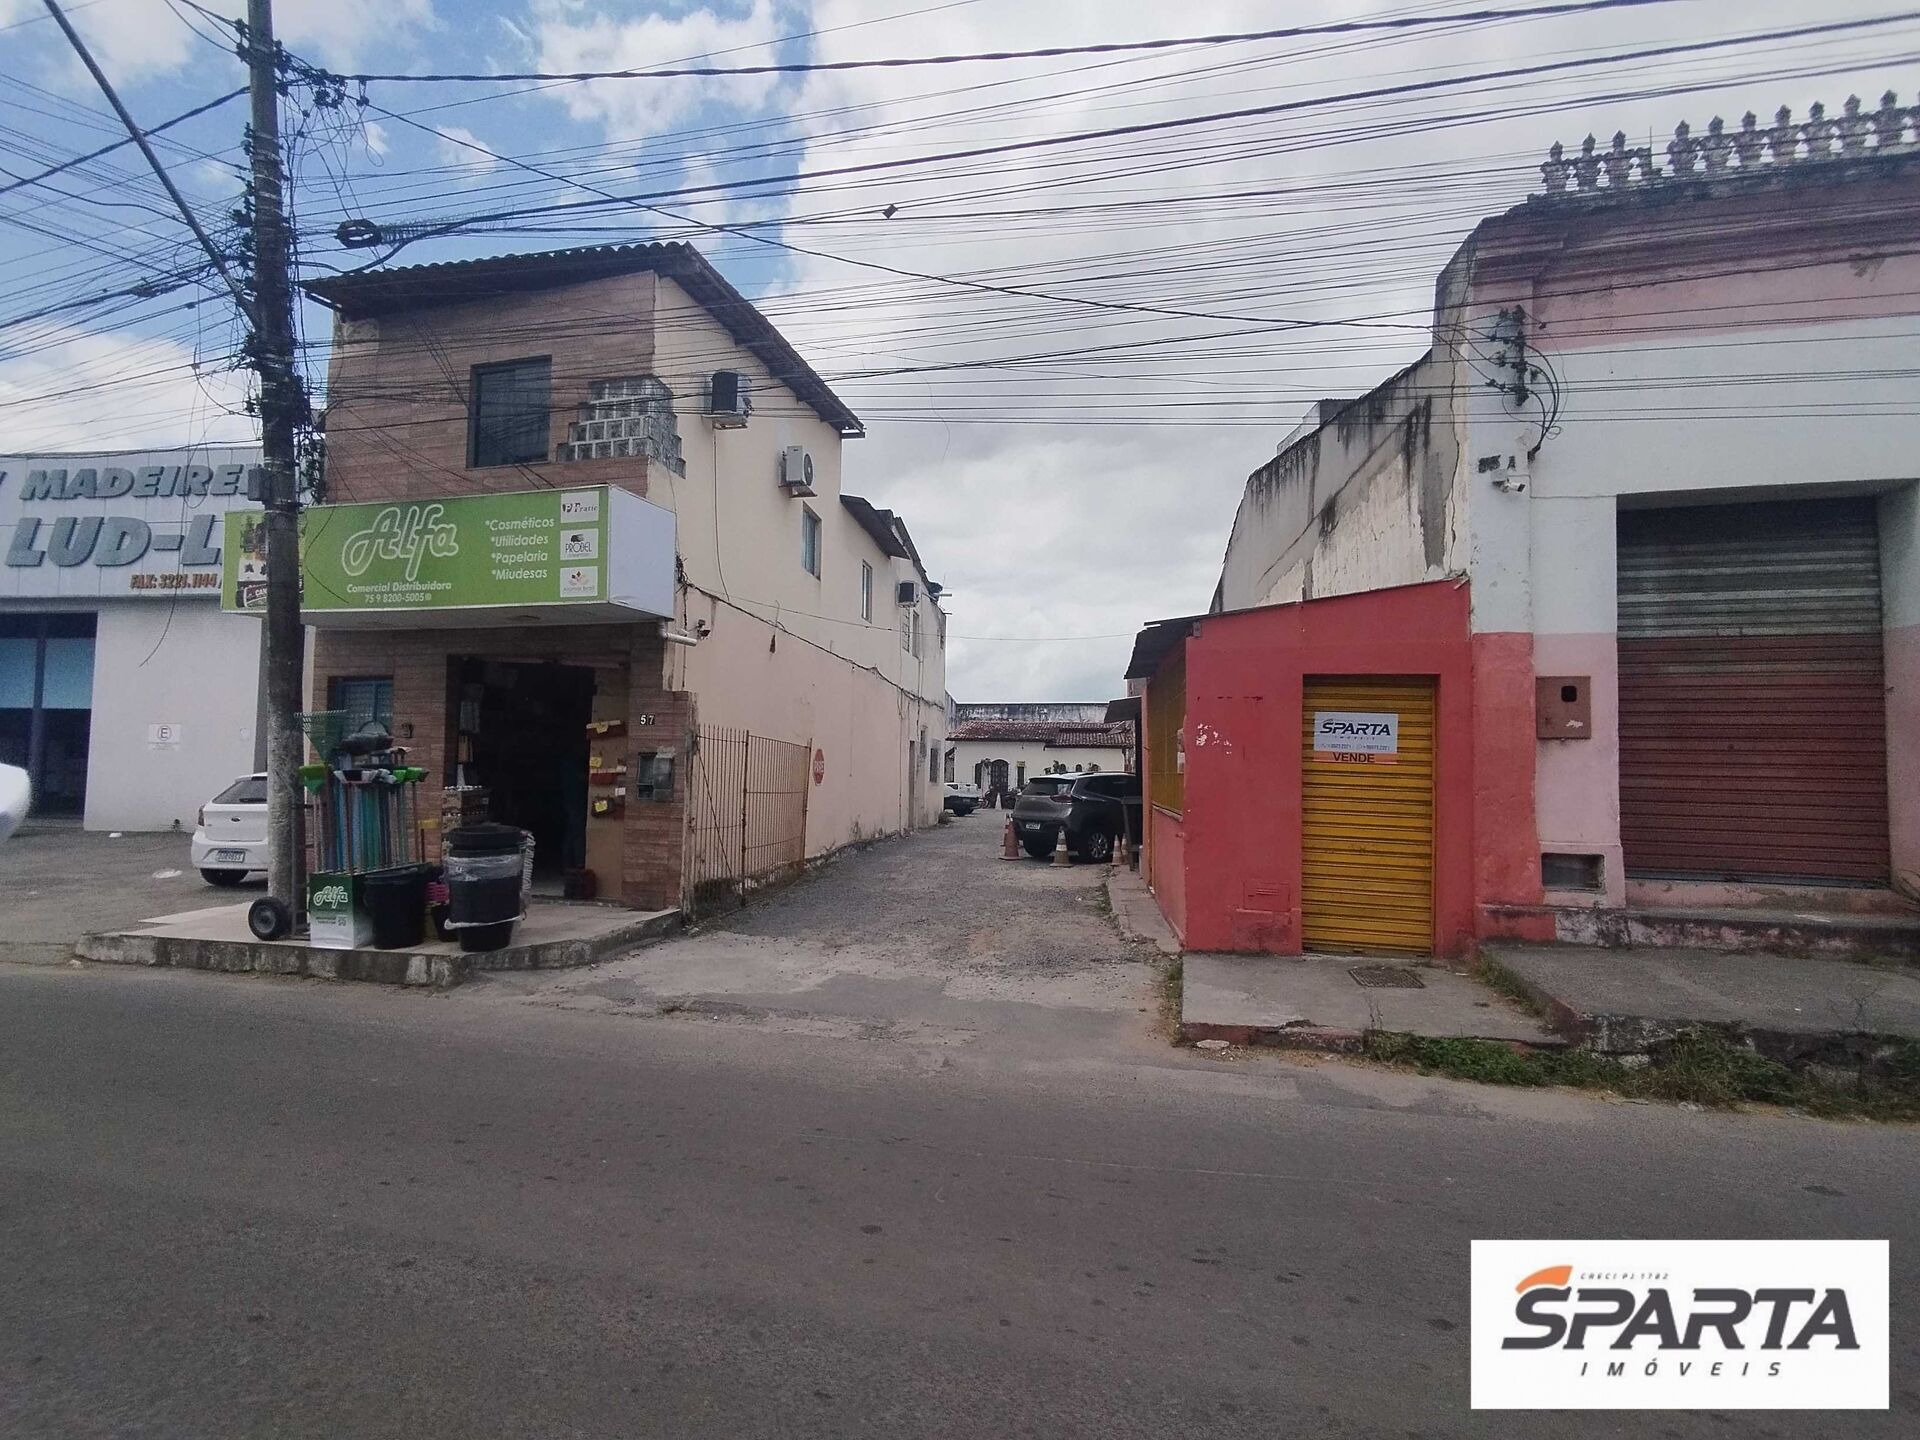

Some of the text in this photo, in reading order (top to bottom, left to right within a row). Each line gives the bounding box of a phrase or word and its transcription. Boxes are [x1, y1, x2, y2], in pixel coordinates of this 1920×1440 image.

[490, 516, 555, 531] Cosméticos
[342, 503, 459, 581] Alfa
[495, 534, 549, 547] Utilidades
[565, 541, 592, 553] PROBEL
[495, 551, 548, 566] Papelaria
[495, 568, 548, 581] Miudesas
[346, 580, 452, 593] Comercial Distribuidora
[640, 714, 655, 725] 57
[160, 727, 169, 738] E
[1320, 721, 1391, 736] SPARTA
[1332, 752, 1375, 763] VENDE
[313, 885, 349, 909] Alfa
